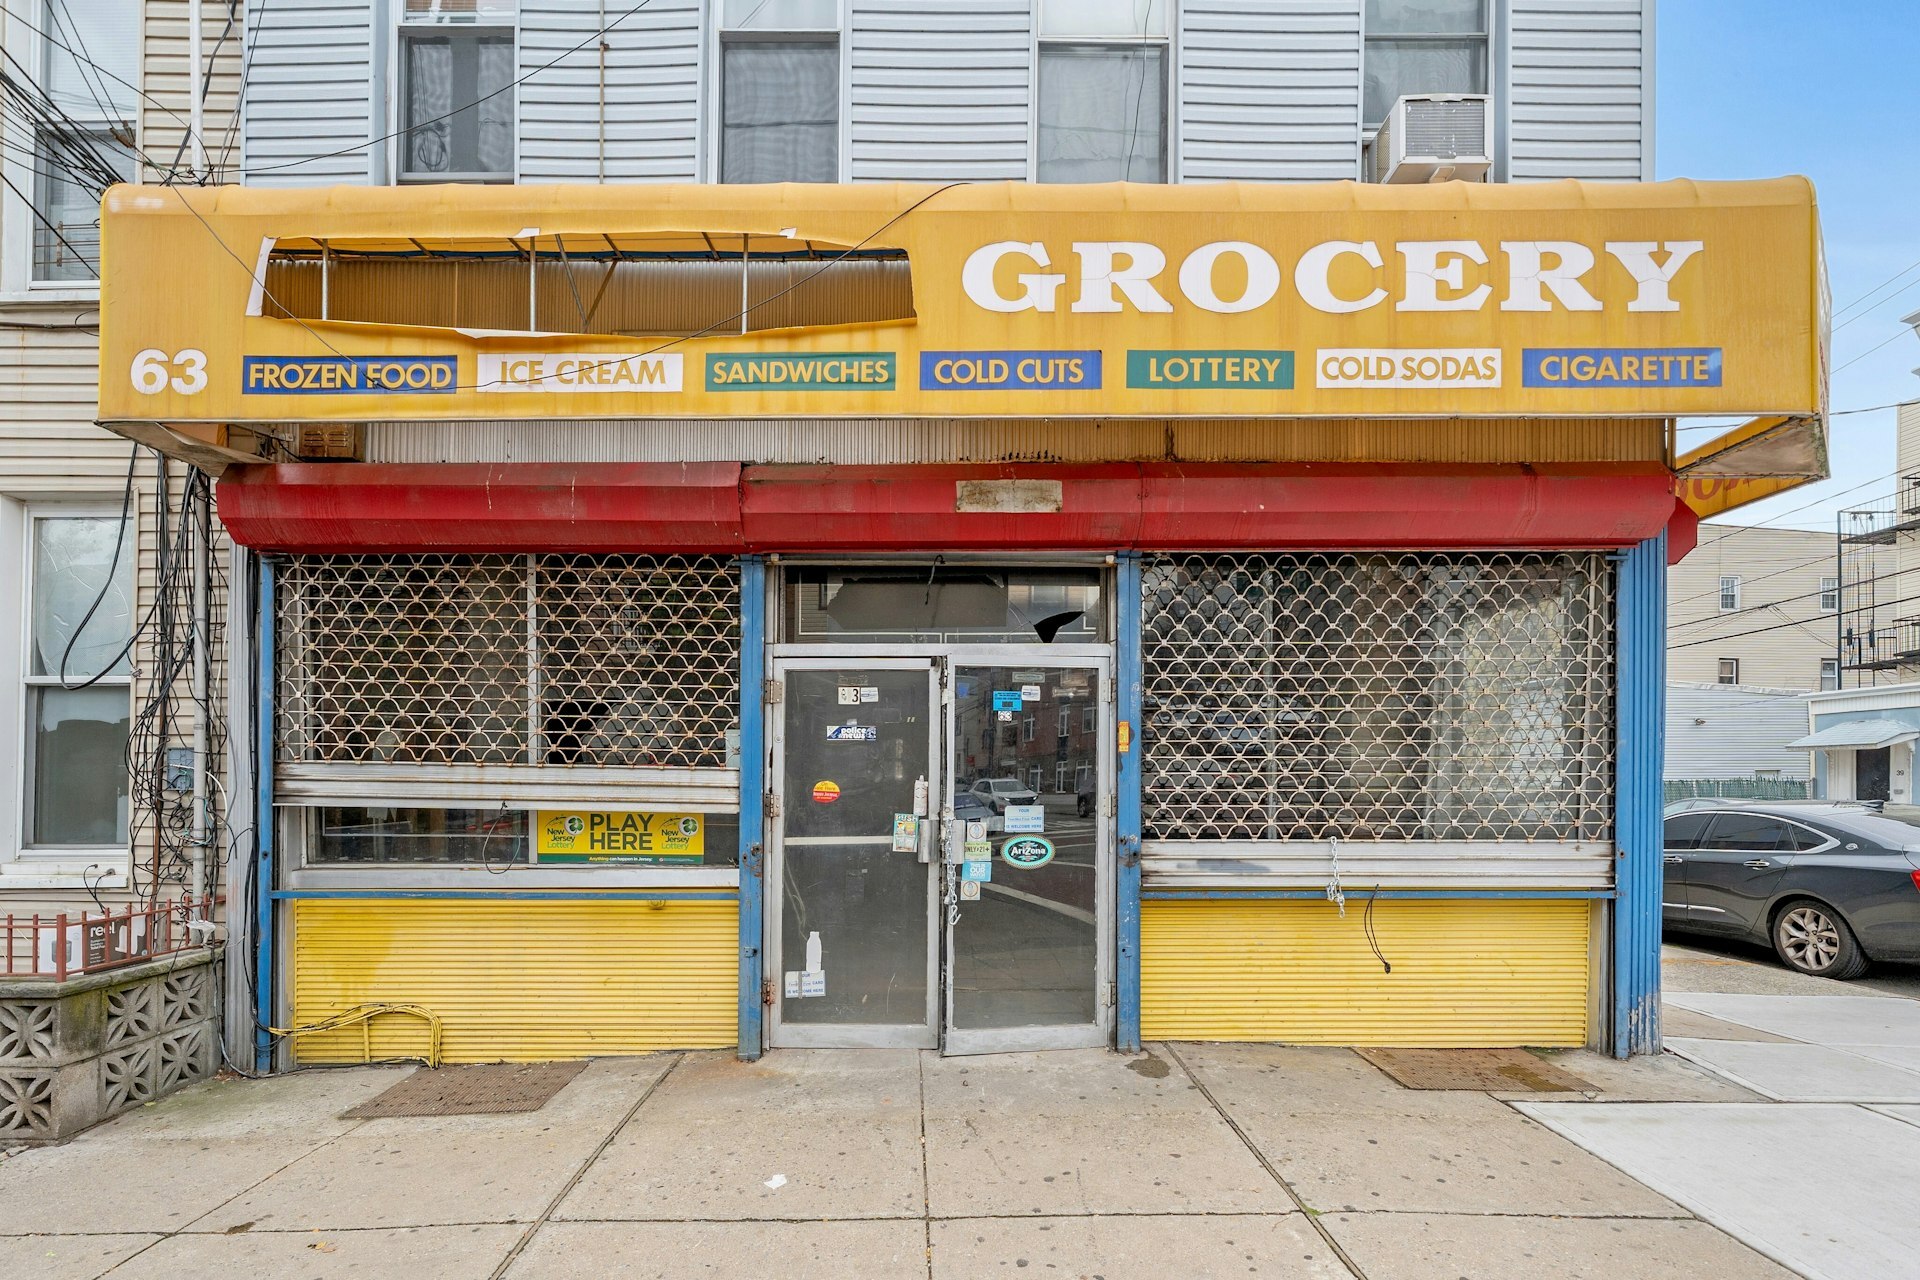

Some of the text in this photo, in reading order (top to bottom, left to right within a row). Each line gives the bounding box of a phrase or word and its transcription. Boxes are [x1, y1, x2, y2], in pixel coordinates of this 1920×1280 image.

[962, 240, 1704, 314] GROCERY
[130, 348, 208, 395] 63
[249, 363, 452, 389] FROZEN FOOD
[500, 360, 666, 386] ICE CREAM
[712, 359, 889, 385] SANDWICHES
[933, 358, 1084, 384] COLD CUTS
[1149, 357, 1281, 383] LOTTERY
[1321, 356, 1497, 381] COLD SODAS
[1540, 355, 1709, 382] CIGARETTE
[1896, 769, 1905, 777] 39
[590, 813, 654, 831] PLAY
[547, 842, 575, 850] Lottery
[551, 835, 576, 843] Jersey
[590, 832, 653, 850] HERE
[661, 843, 689, 851] Lottery
[665, 836, 690, 844] Jersey
[1010, 846, 1046, 857] AriZona
